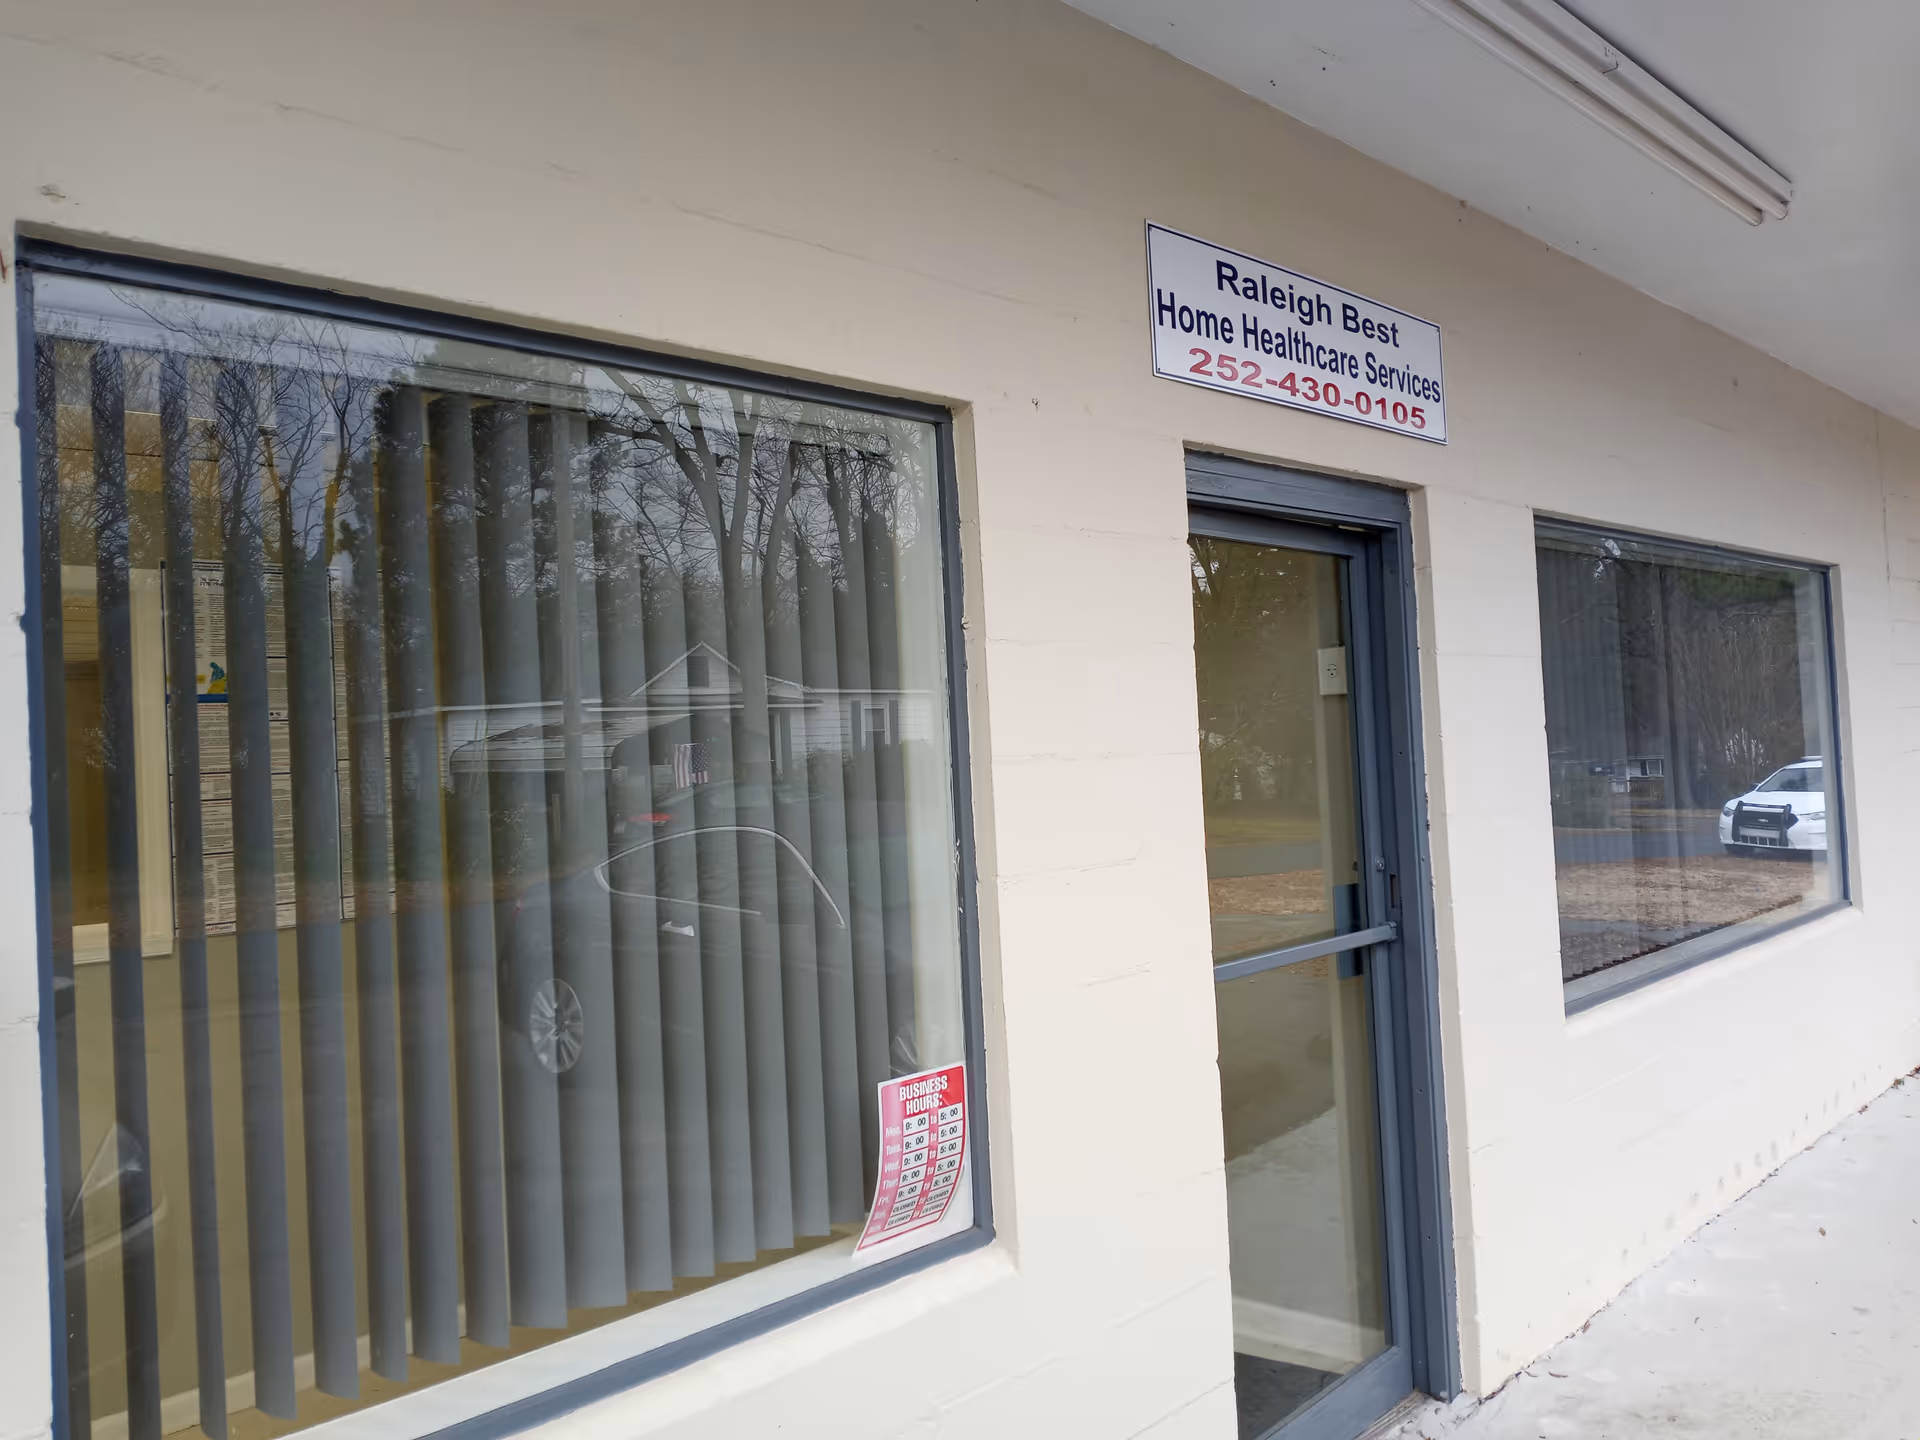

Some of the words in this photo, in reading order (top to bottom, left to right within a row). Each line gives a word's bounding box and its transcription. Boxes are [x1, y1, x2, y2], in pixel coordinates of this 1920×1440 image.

[1215, 259, 1332, 327] Raleigh
[1341, 302, 1400, 348] Best
[1156, 288, 1234, 344] Home
[1241, 313, 1359, 380] Healthcare
[1365, 351, 1441, 403] Services
[1188, 347, 1426, 430] 252-430-0105
[899, 1075, 948, 1101] BUSINESS
[906, 1093, 943, 1115] HOURS:
